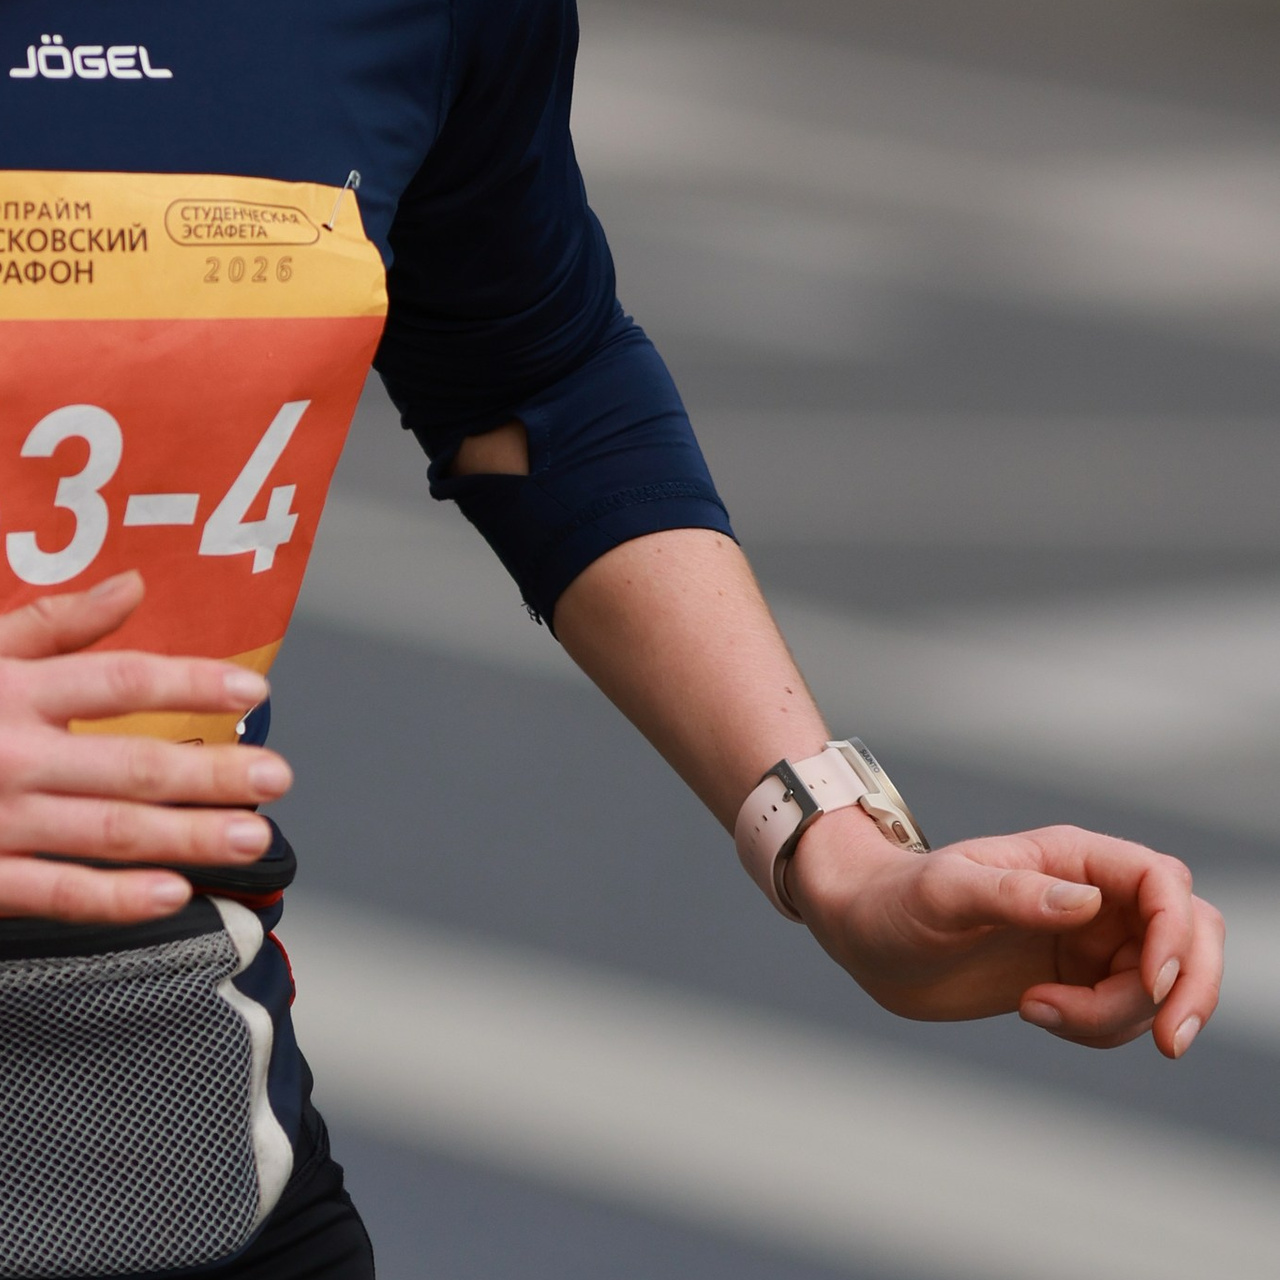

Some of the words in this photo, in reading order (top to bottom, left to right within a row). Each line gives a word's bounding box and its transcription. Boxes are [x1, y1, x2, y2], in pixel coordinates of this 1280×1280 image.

[9, 34, 173, 79] JÖGEL
[180, 205, 301, 225] СТУДЕНЧЕСКАЯ
[182, 222, 269, 240] ЭСТАФЕТА
[203, 256, 294, 284] 2026
[860, 749, 880, 773] SUUNTO
